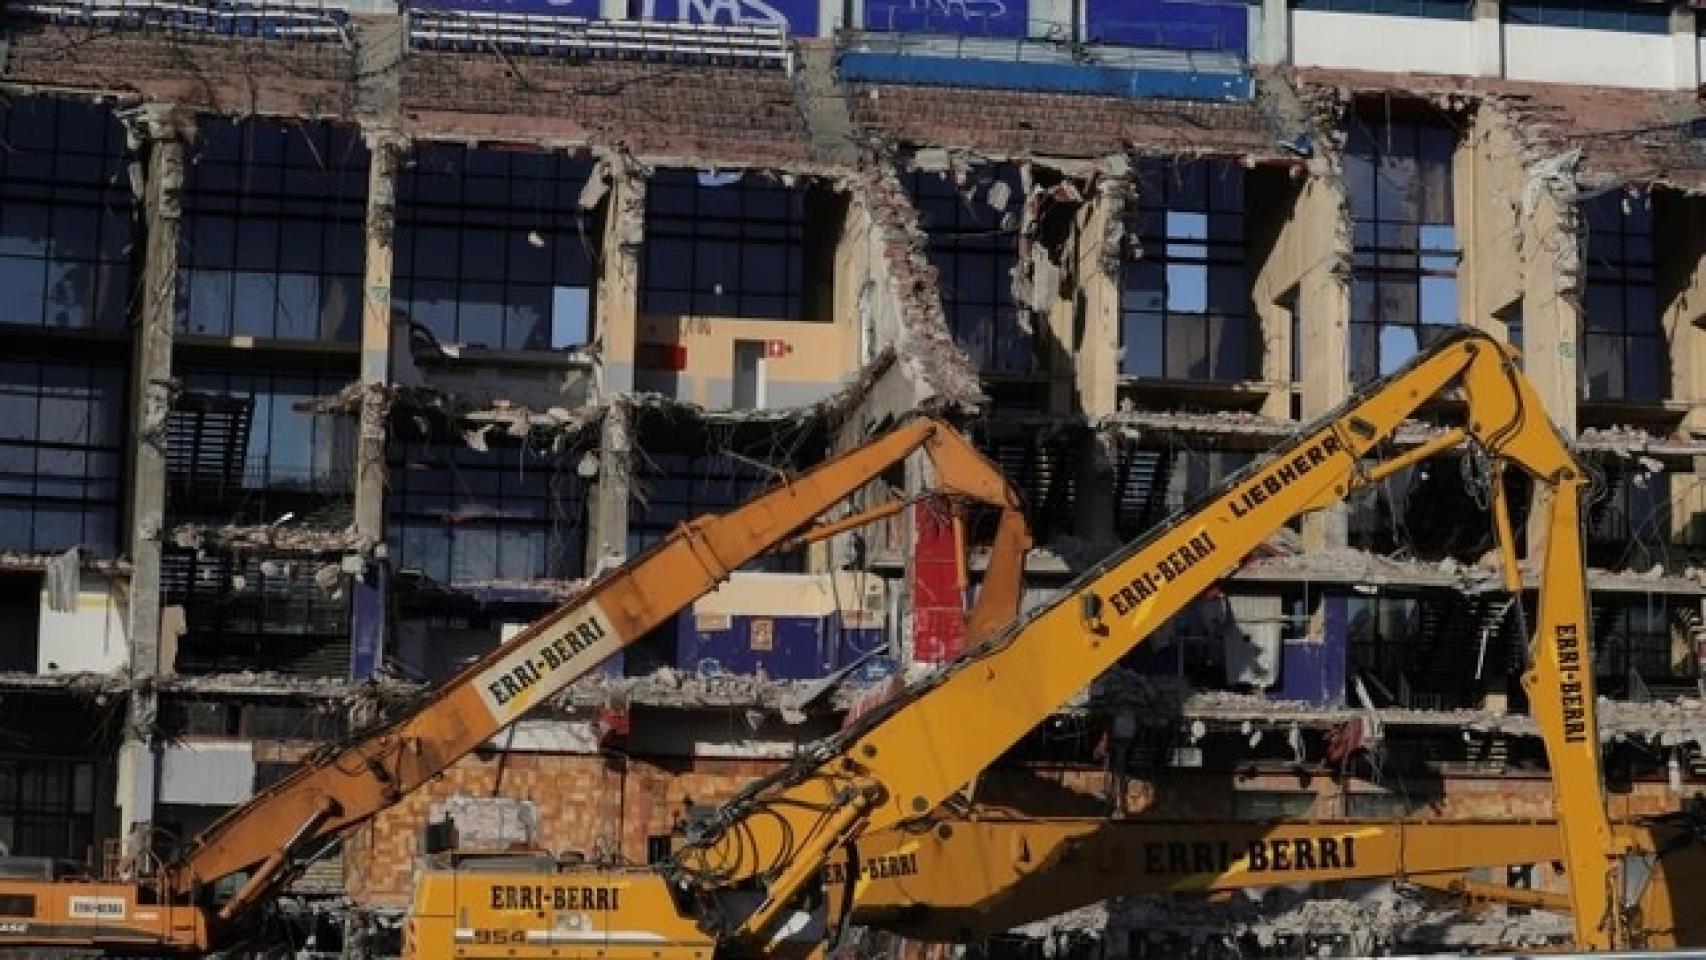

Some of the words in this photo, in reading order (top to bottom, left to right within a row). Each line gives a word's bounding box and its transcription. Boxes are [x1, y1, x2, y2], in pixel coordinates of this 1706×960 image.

[1228, 434, 1341, 518] LIEBHERR
[1108, 529, 1217, 617] ERRI-BERRI
[488, 615, 606, 706] ERRI-BERRI
[1555, 624, 1587, 743] ERRI-BERRI
[823, 853, 918, 884] ER-BERRI
[1143, 835, 1356, 875] ERRI-BERRI
[490, 884, 620, 911] ERRI-BERRI
[474, 928, 526, 945] 954
